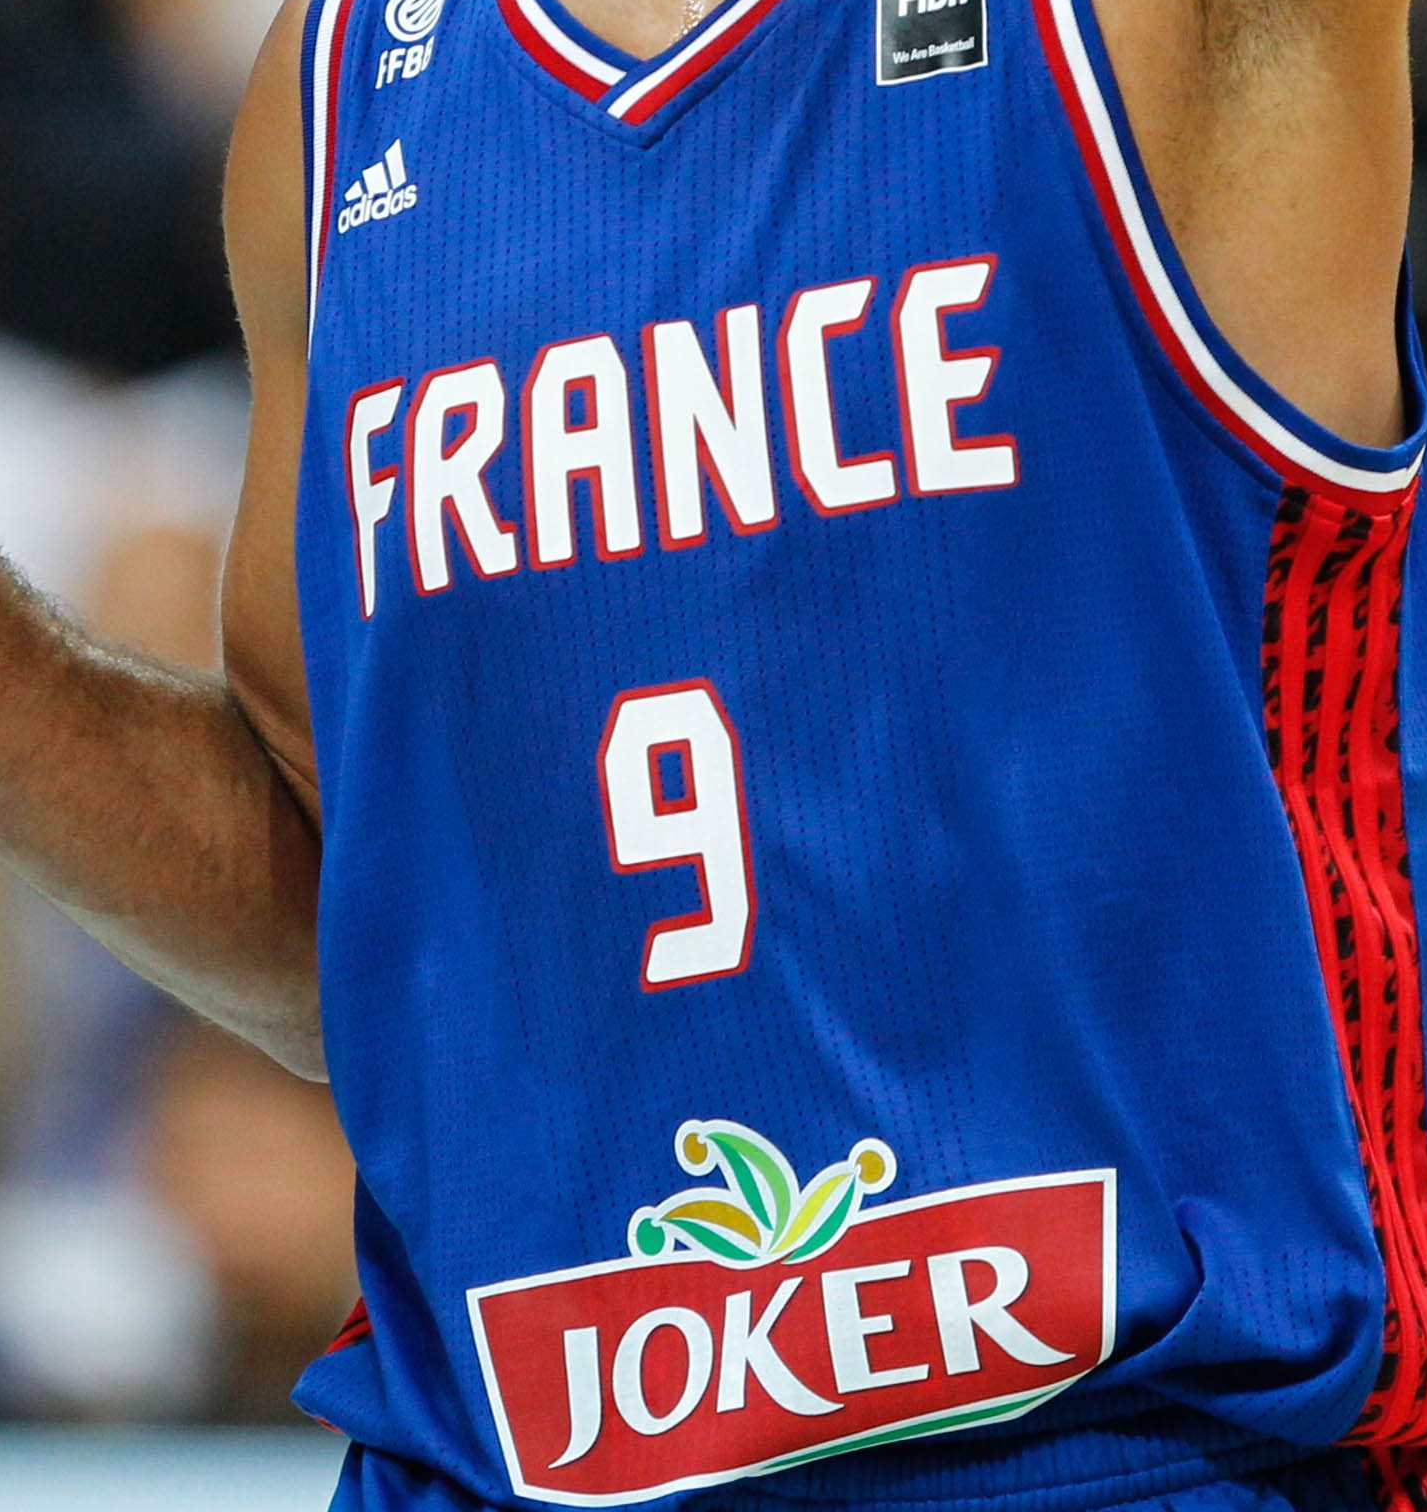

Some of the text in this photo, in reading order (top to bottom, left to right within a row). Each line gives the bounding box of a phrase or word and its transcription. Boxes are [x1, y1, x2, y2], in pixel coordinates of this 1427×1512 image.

[893, 51, 910, 64] We
[910, 48, 928, 61] Are
[337, 184, 418, 234] adidas
[344, 253, 1018, 620] FRANCE
[596, 677, 757, 993] 9
[548, 1245, 1077, 1470] JOKER
